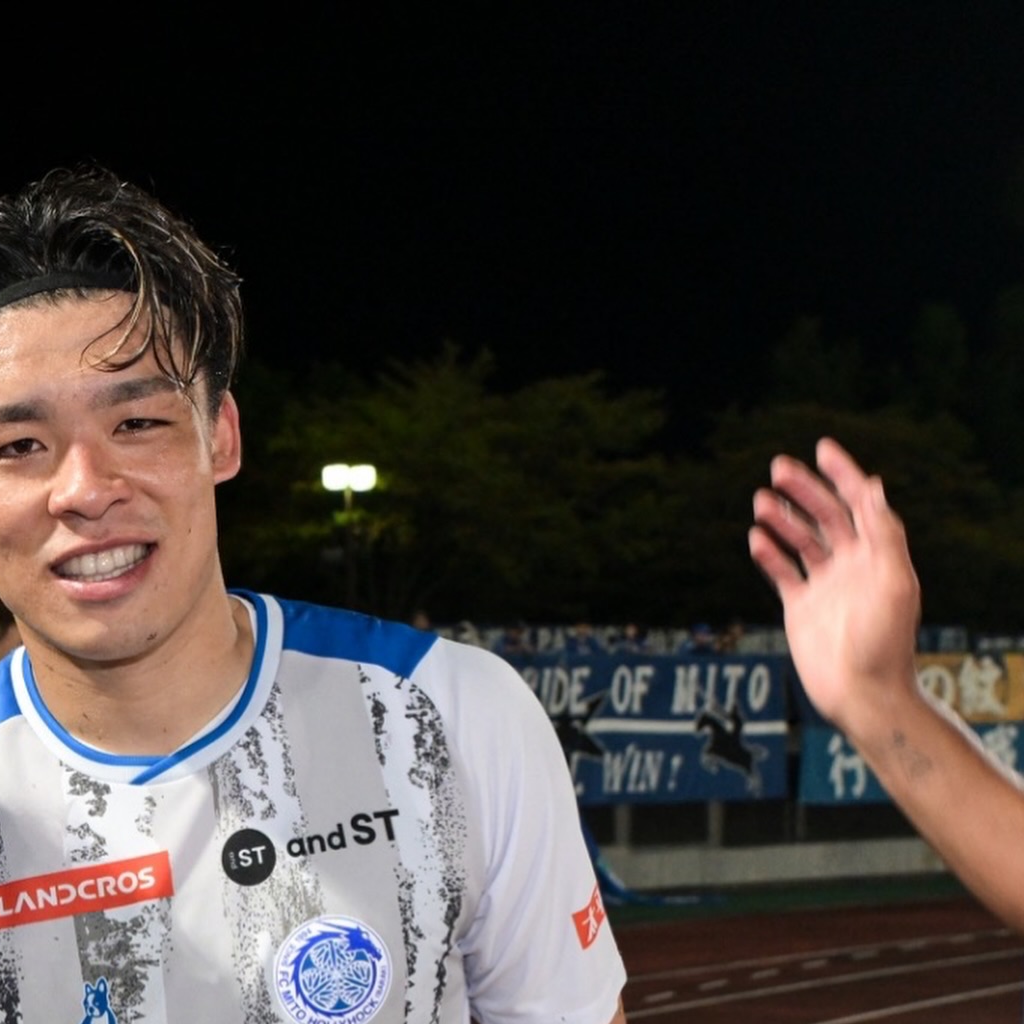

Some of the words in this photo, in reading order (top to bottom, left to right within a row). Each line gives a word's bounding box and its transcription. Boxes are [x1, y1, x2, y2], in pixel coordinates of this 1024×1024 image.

[610, 664, 655, 714] OF
[671, 663, 772, 714] MITO
[602, 743, 684, 794] WIN!
[238, 845, 267, 867] ST
[286, 822, 347, 858] and
[350, 809, 400, 845] ST
[281, 990, 307, 1020] MITO
